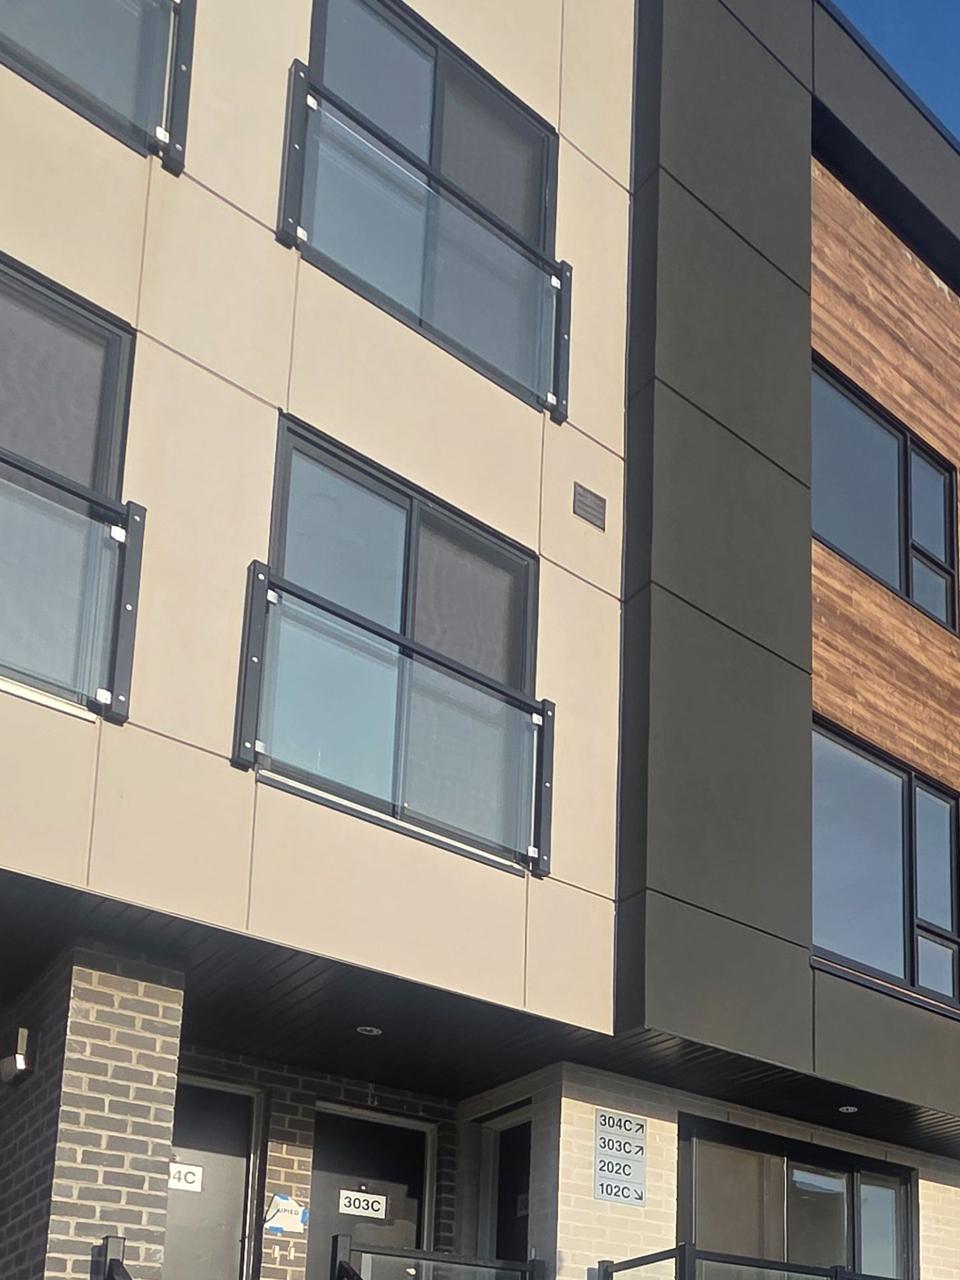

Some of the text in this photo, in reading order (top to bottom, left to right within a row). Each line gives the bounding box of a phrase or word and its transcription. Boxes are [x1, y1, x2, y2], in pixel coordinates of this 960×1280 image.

[599, 1114, 633, 1132] 304C
[599, 1137, 632, 1154] 303C
[172, 1170, 196, 1184] 4C
[598, 1160, 632, 1177] 202C
[598, 1182, 631, 1199] 102C
[279, 1207, 300, 1216] UPIED
[343, 1195, 381, 1212] 303C
